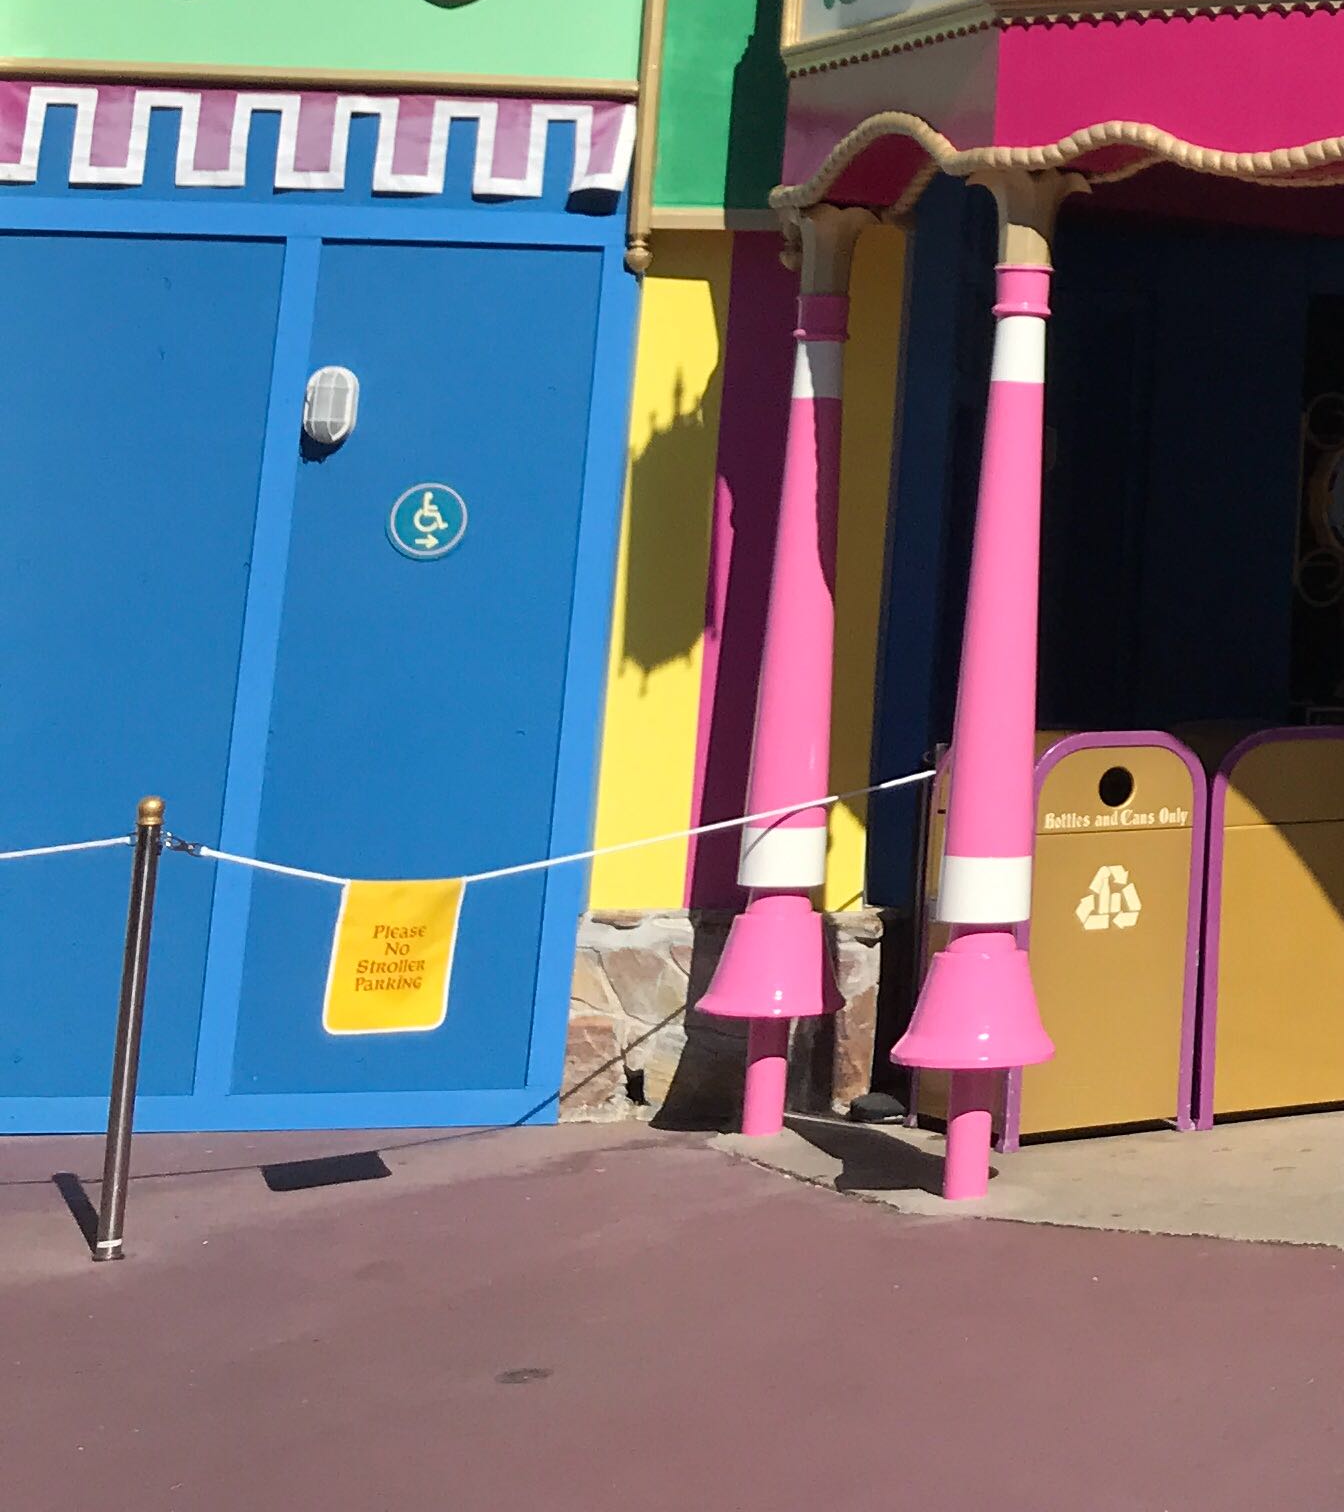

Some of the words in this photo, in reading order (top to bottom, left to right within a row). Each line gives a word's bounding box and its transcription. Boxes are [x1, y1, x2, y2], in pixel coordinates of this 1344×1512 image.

[1044, 812, 1090, 829] Bottles
[1094, 810, 1118, 827] and
[1119, 809, 1155, 826] Cans
[1159, 806, 1188, 826] Only
